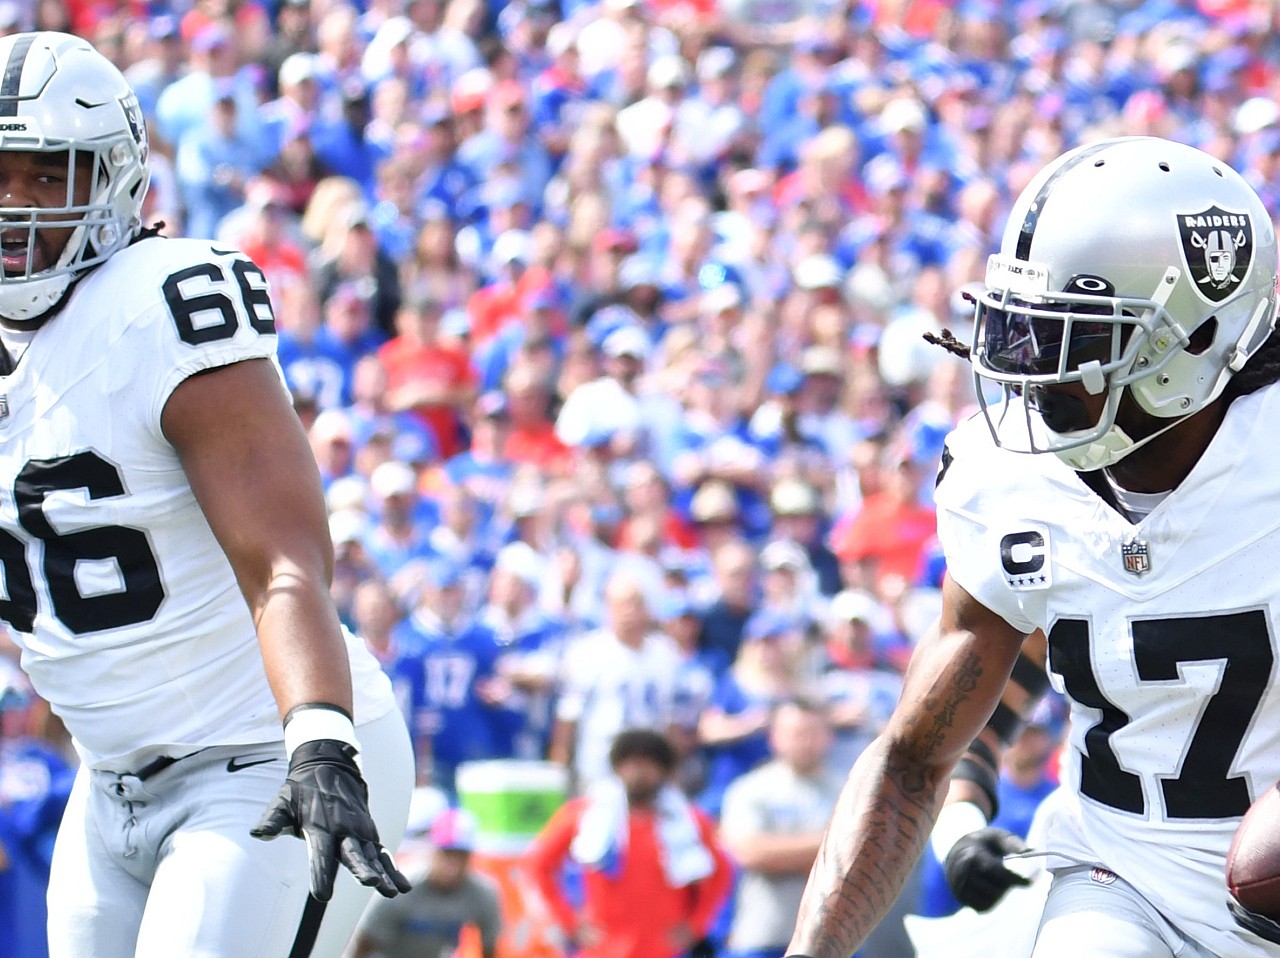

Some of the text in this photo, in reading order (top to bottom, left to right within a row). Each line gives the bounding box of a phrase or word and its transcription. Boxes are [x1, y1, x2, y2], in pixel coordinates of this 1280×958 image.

[1184, 215, 1246, 228] RAIDERS
[161, 259, 277, 346] 66
[1000, 531, 1045, 575] C
[1126, 555, 1149, 572] NFL
[1047, 606, 1276, 821] 17
